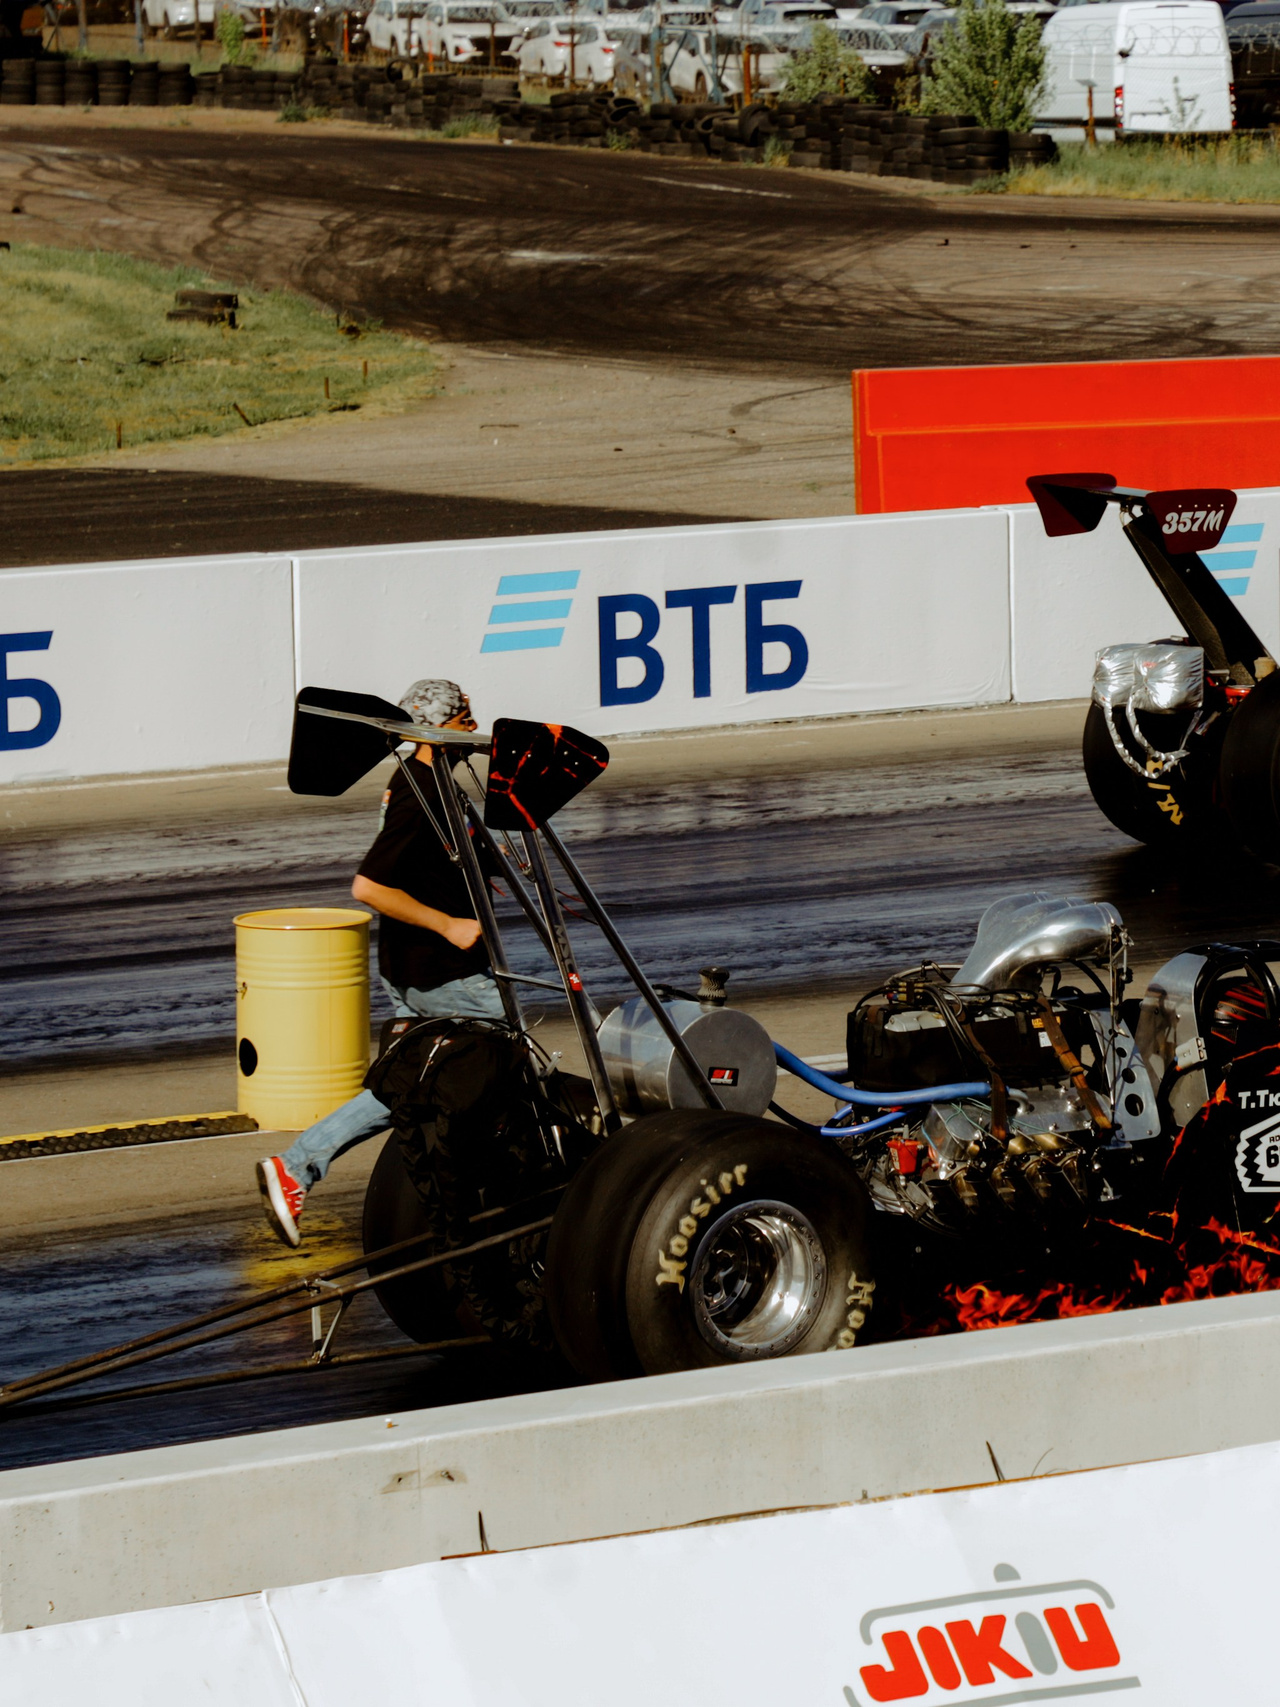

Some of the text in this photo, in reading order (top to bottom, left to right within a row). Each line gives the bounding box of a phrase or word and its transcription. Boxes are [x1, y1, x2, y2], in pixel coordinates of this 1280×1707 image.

[1162, 509, 1225, 535] 357M
[598, 580, 809, 707] ВТБ
[655, 1163, 747, 1294] Hoosier
[859, 1602, 1121, 1702] JIKIU
